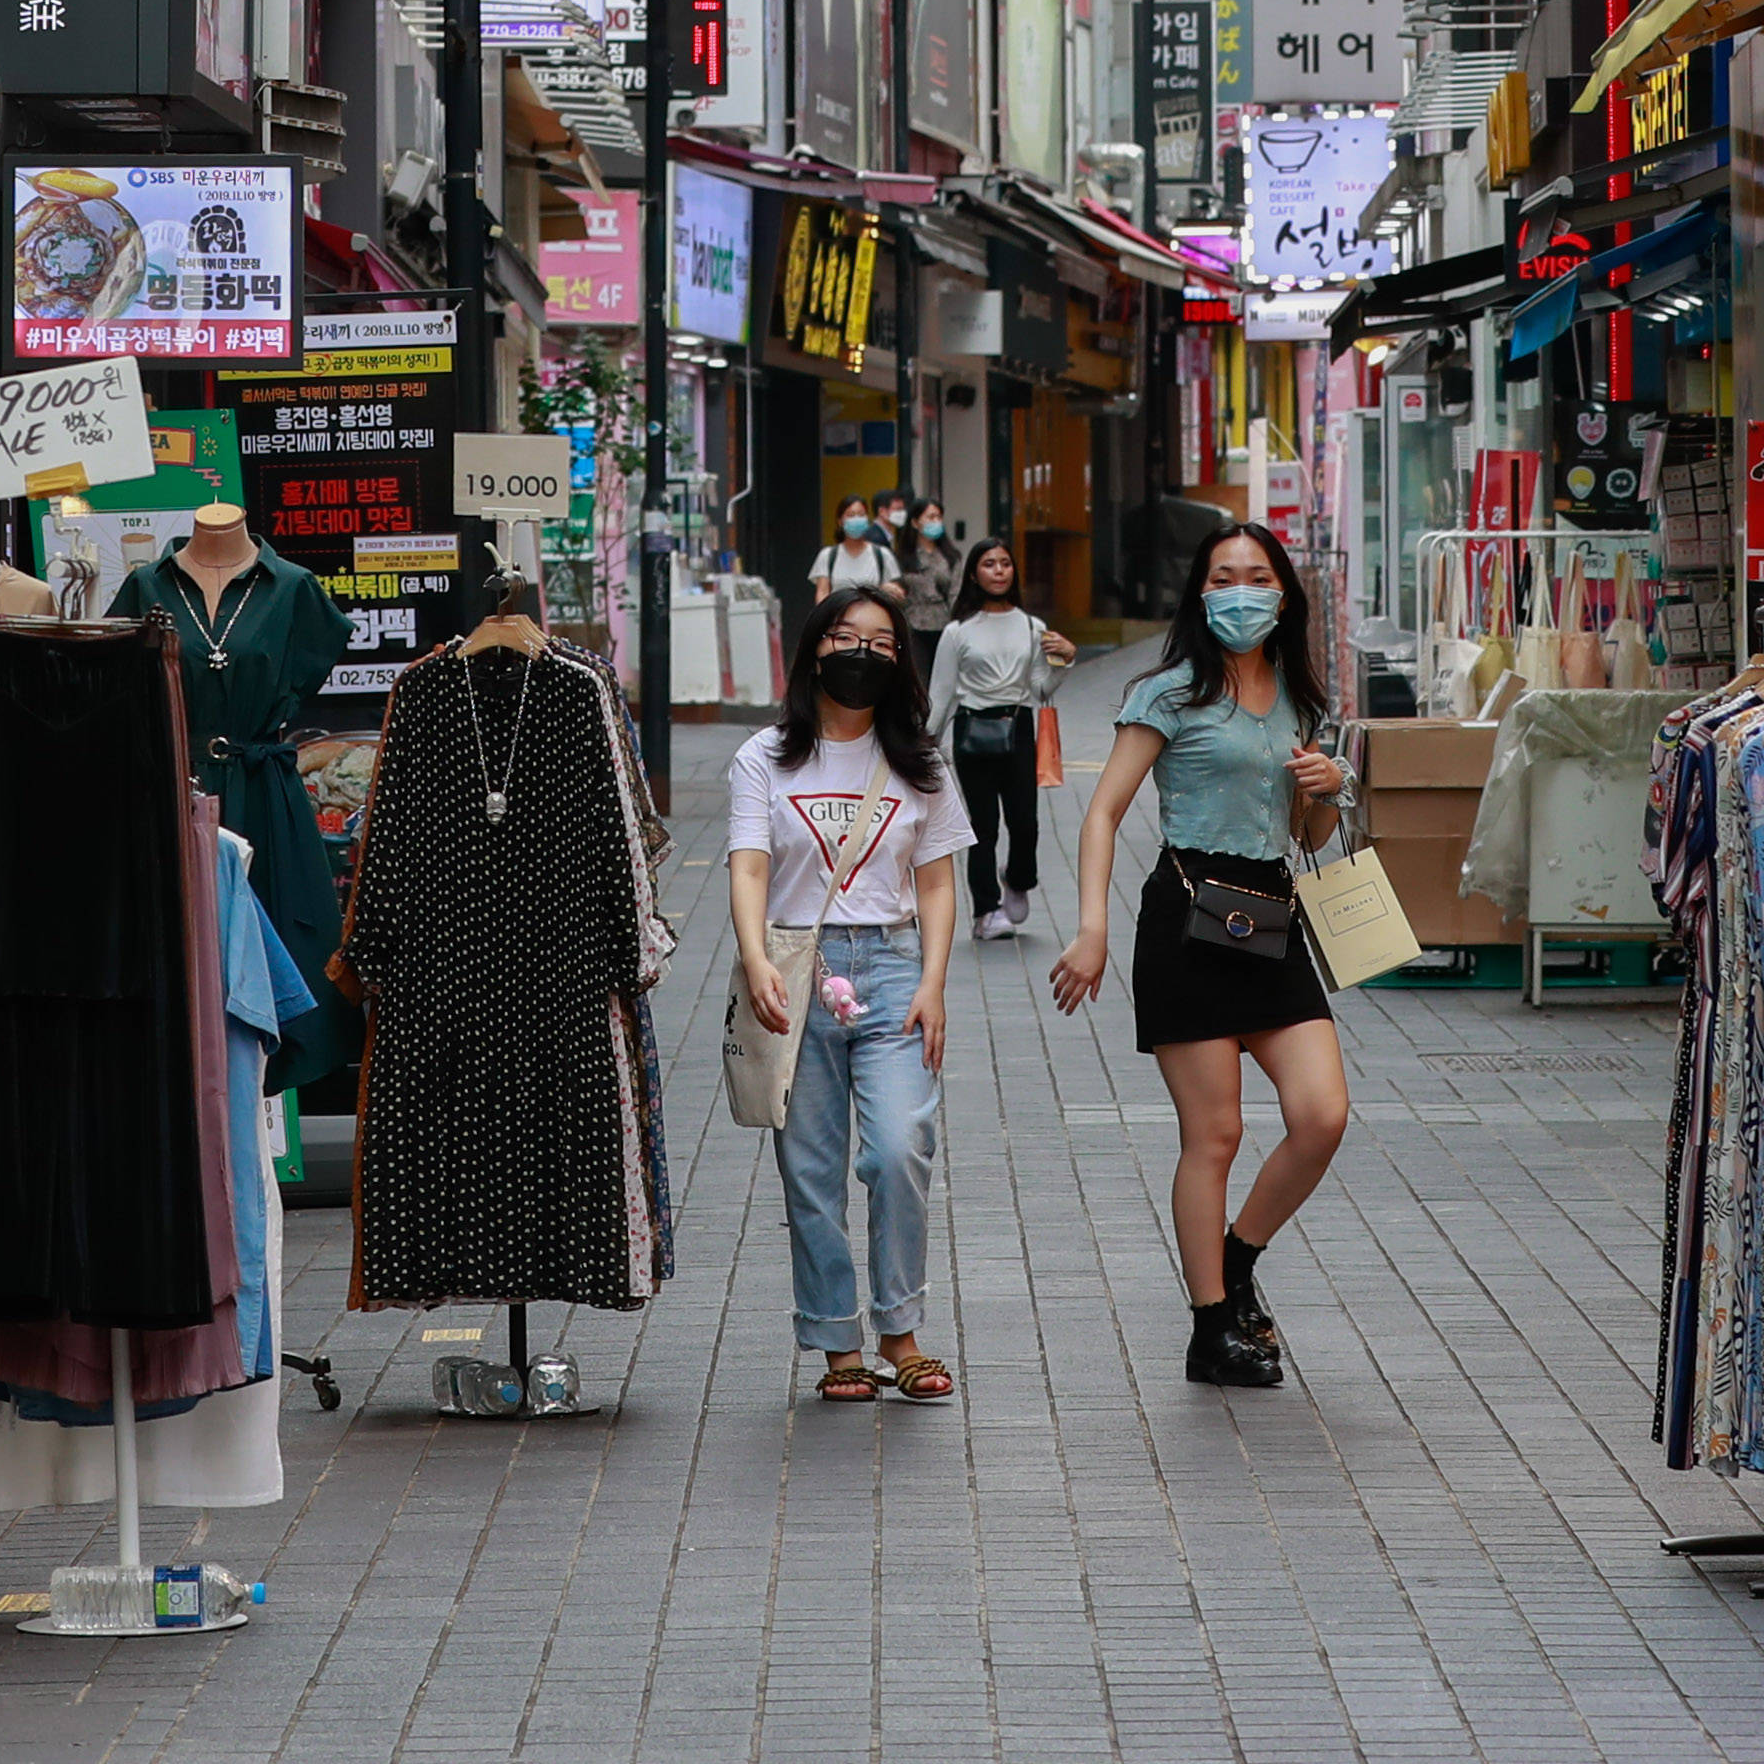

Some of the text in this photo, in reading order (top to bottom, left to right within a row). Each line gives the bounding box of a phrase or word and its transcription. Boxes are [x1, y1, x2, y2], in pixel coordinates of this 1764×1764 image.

[1272, 32, 1375, 75] 헤어
[149, 171, 175, 185] SBS
[146, 273, 283, 312] 명동화떡
[597, 282, 624, 308] 4F
[25, 325, 284, 355] #미우새곱창떡볶이 #화떡
[240, 428, 435, 455] 미운우리새끼 치팅데이 맛집!
[281, 476, 401, 507] 홍자매 방문
[271, 506, 414, 536] 치팅데이 맛집
[809, 801, 883, 824] GUES
